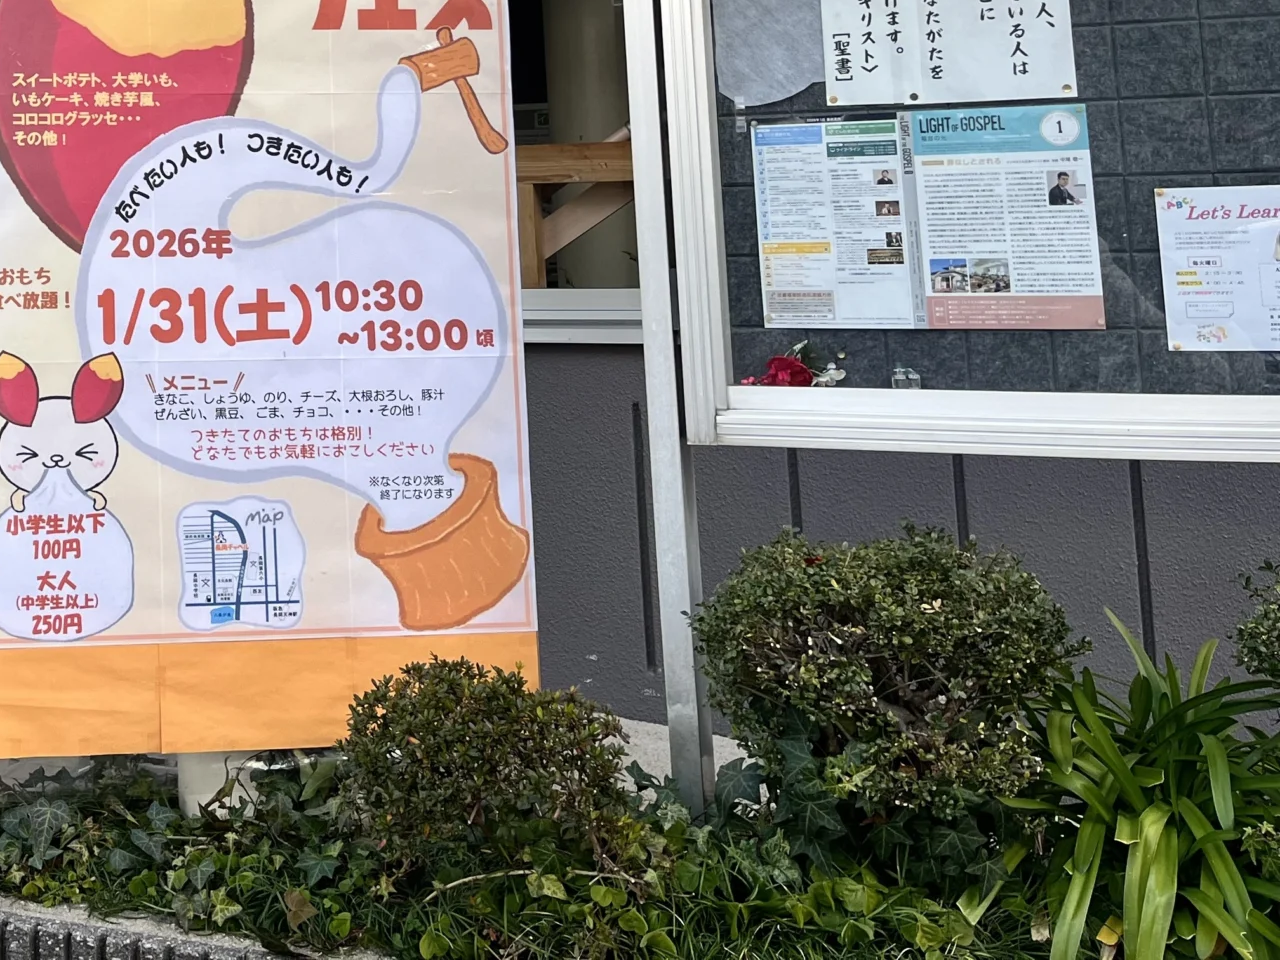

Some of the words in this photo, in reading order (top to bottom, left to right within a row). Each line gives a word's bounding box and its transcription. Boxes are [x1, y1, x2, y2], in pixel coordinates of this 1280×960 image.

[900, 121, 911, 138] LIGHT
[919, 115, 952, 134] LIGHT
[951, 124, 959, 133] OF
[960, 114, 1006, 132] GOSPEL
[1056, 120, 1064, 134] 1
[12, 130, 67, 147] その他！
[902, 147, 913, 170] GOSPEL
[114, 133, 226, 223] たべたい人も！
[246, 133, 369, 194] つきたい人も！
[1166, 197, 1190, 210] ABC
[1185, 204, 1232, 220] Let's
[109, 227, 234, 259] 2026年
[314, 279, 424, 313] 10:30
[97, 283, 313, 347] 1/31(土)
[476, 329, 495, 348] 頃
[162, 375, 228, 391] メニュー
[191, 426, 372, 443] つきたてのおもちは格別！
[191, 442, 435, 461] どなたでもお気軽におこしください
[379, 488, 455, 500] 終了になります
[6, 513, 106, 536] 小学生以下
[245, 510, 284, 526] Map
[32, 538, 81, 560] 100円
[36, 570, 77, 592] 大人
[16, 593, 99, 611] (中学生以上)
[31, 613, 83, 635] 250円
